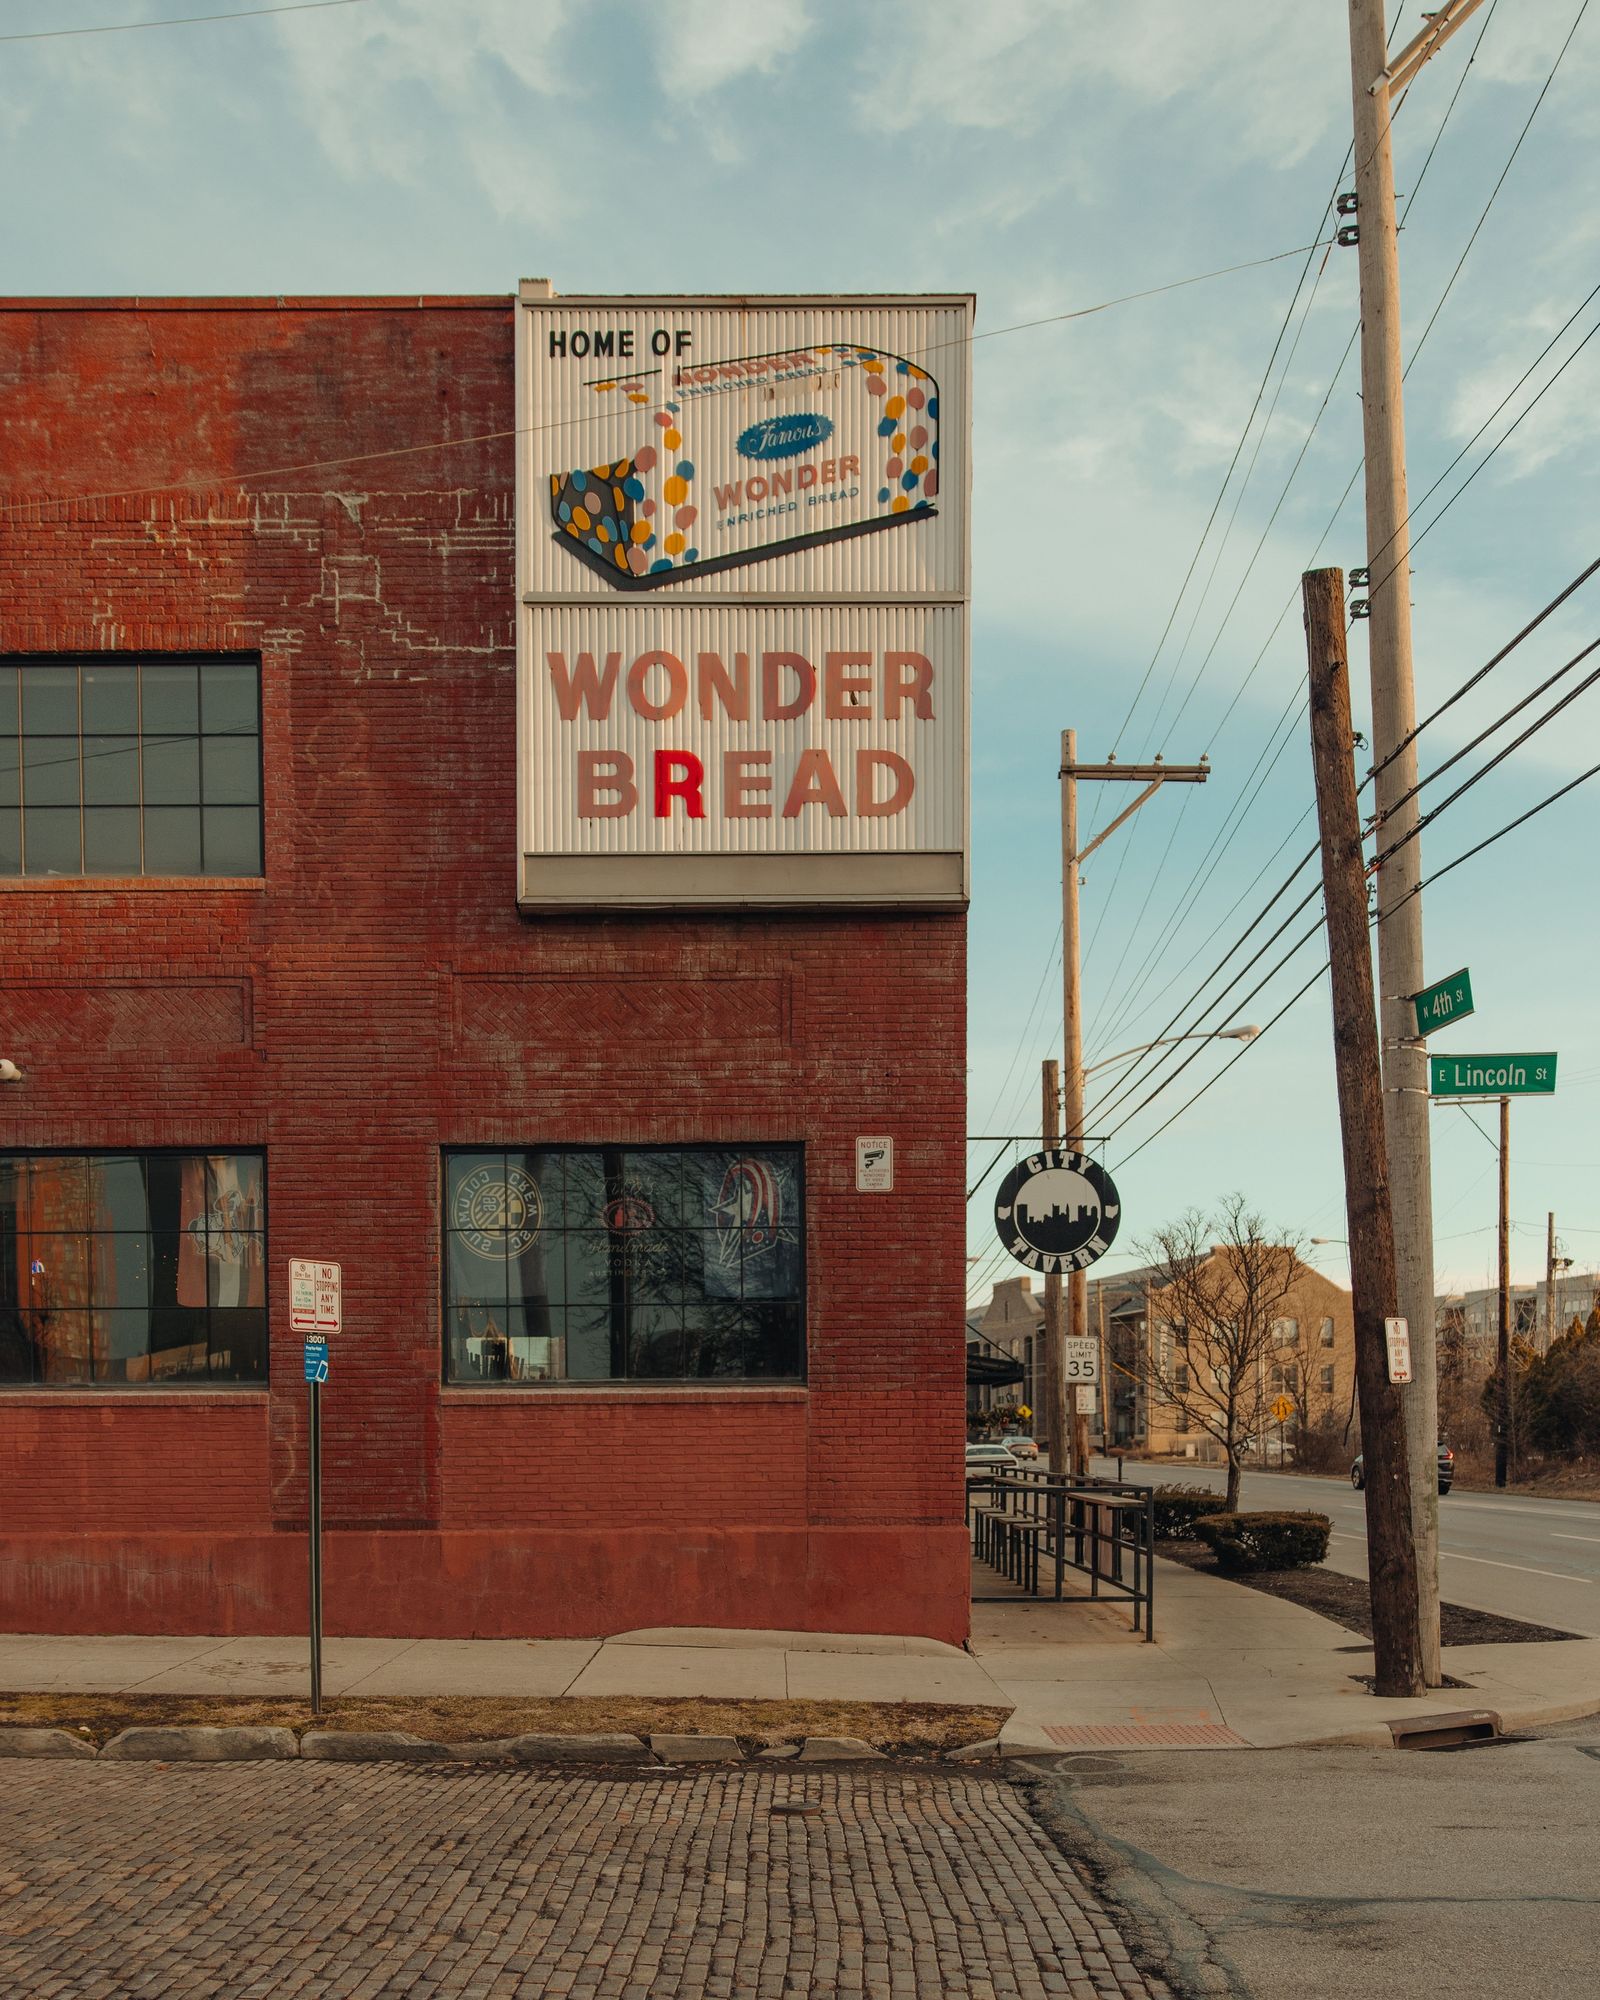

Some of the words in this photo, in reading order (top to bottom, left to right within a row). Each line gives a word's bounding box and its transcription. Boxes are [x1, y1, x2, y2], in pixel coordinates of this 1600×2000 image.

[549, 330, 634, 358] HOME
[651, 330, 692, 357] OF
[676, 377, 767, 398] ENRICHED
[775, 367, 827, 381] BREAD
[748, 419, 822, 454] Famous
[713, 455, 860, 512] WONDER
[716, 502, 798, 531] ENRICHED
[808, 487, 859, 507] BREAD
[547, 650, 936, 721] WONDER
[577, 749, 915, 819] BREAD
[1423, 1006, 1428, 1019] N
[1432, 991, 1453, 1018] 4th
[1456, 989, 1464, 1003] St
[1439, 1069, 1446, 1082] E
[1455, 1063, 1526, 1087] Lincoln
[1535, 1067, 1547, 1080] St
[1026, 1151, 1094, 1175] CITY
[604, 1259, 652, 1267] VODKA
[1009, 1234, 1109, 1273] TAVERN
[322, 1268, 332, 1280] NO
[316, 1280, 338, 1293] STOPPING
[321, 1294, 333, 1303] ANY
[320, 1305, 335, 1314] TIME
[1393, 1325, 1400, 1335] NO
[1067, 1341, 1096, 1350] SPEED
[1068, 1360, 1094, 1377] 35
